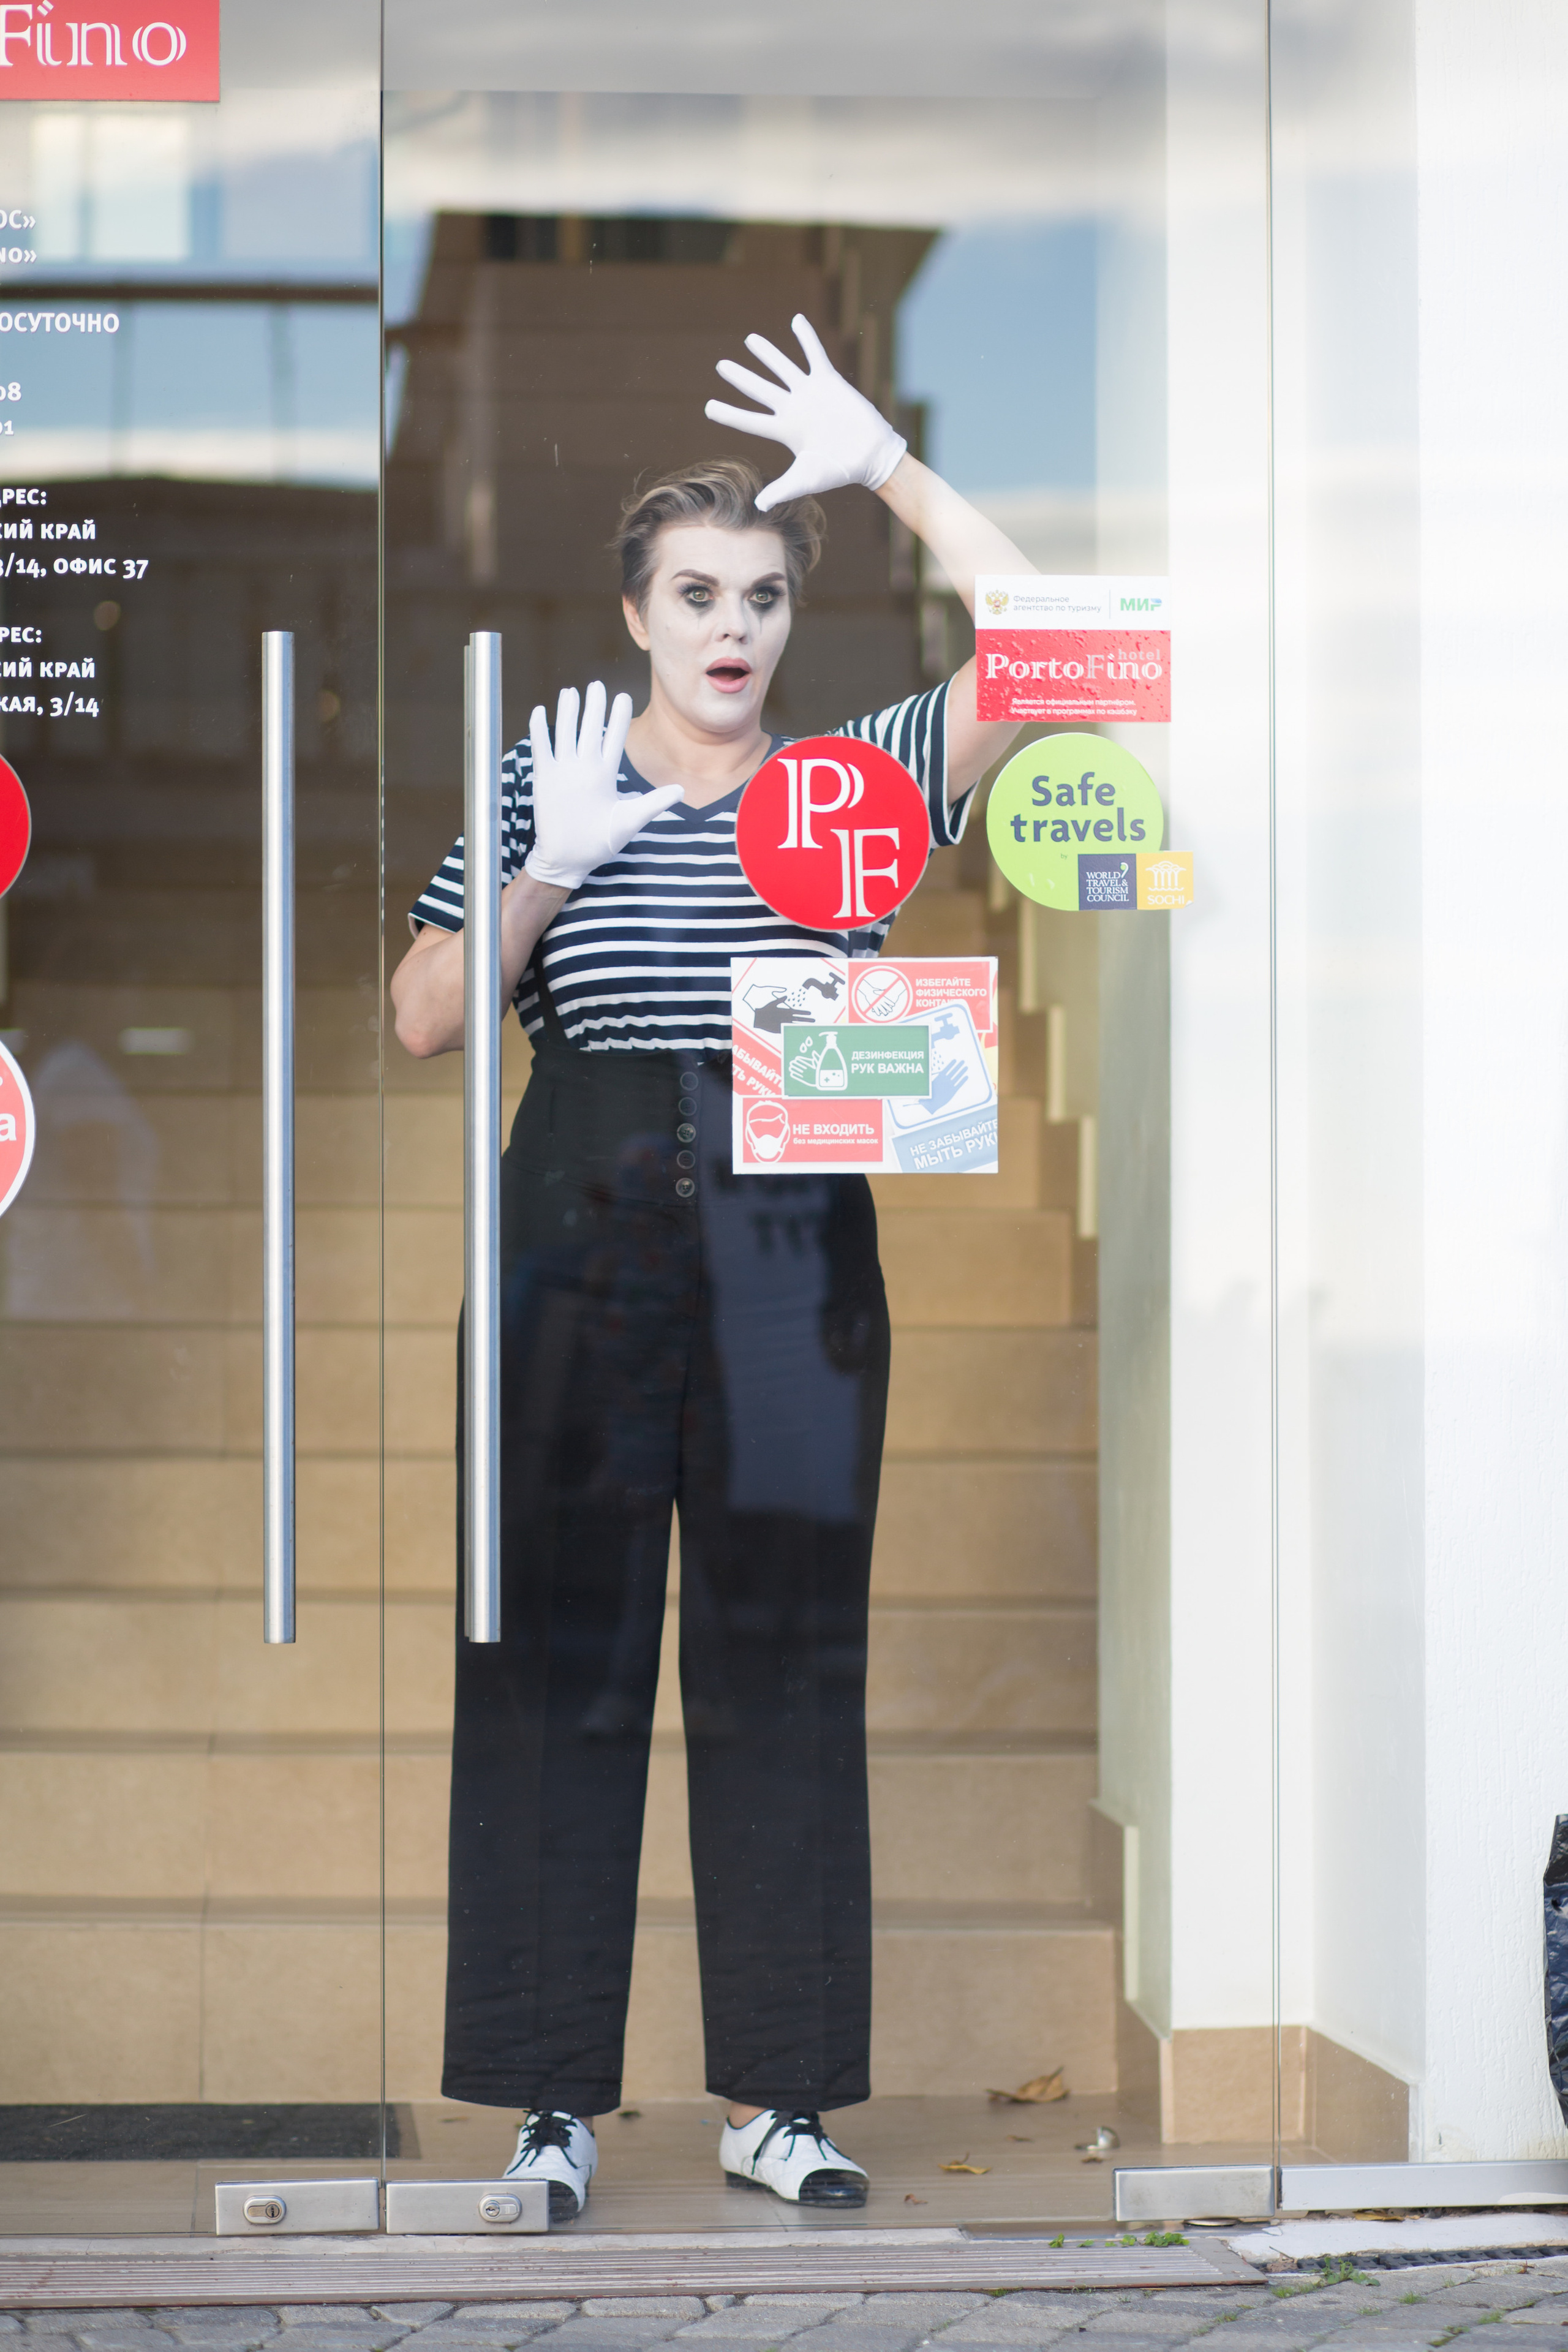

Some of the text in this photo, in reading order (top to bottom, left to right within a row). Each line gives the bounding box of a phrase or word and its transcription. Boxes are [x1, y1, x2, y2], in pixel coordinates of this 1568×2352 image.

[0, 0, 187, 66] Fino
[0, 312, 120, 333] ОСУТОЧНО
[0, 420, 14, 435] 1
[0, 488, 47, 507] РЕС:
[0, 519, 96, 540] ИЙ КРАЙ
[0, 552, 149, 579] /14, ОФИС 37
[1068, 605, 1101, 613] туризму
[1120, 598, 1163, 611] МИР
[1118, 649, 1161, 660] hotel
[0, 657, 96, 678] ИЙ КРАЙ
[986, 653, 1163, 679] PortoFino
[50, 691, 99, 717] 3/14
[1011, 707, 1046, 715] Участвует
[1031, 772, 1116, 807] Safe
[1010, 807, 1146, 843] travels
[1147, 895, 1185, 905] SOCHI
[916, 977, 971, 987] ИЗБЕГАЙТЕ
[916, 988, 987, 997] ФИЗИЧЕСКОГО
[851, 1051, 924, 1061] ДЕЗИНФЕКЦИЯ
[851, 1063, 924, 1074] РУК ВАЖНА
[793, 1124, 875, 1136] НЕ ВХОДИТЬ
[910, 1143, 927, 1156] НЕ
[914, 1146, 963, 1170] МЫТЬ
